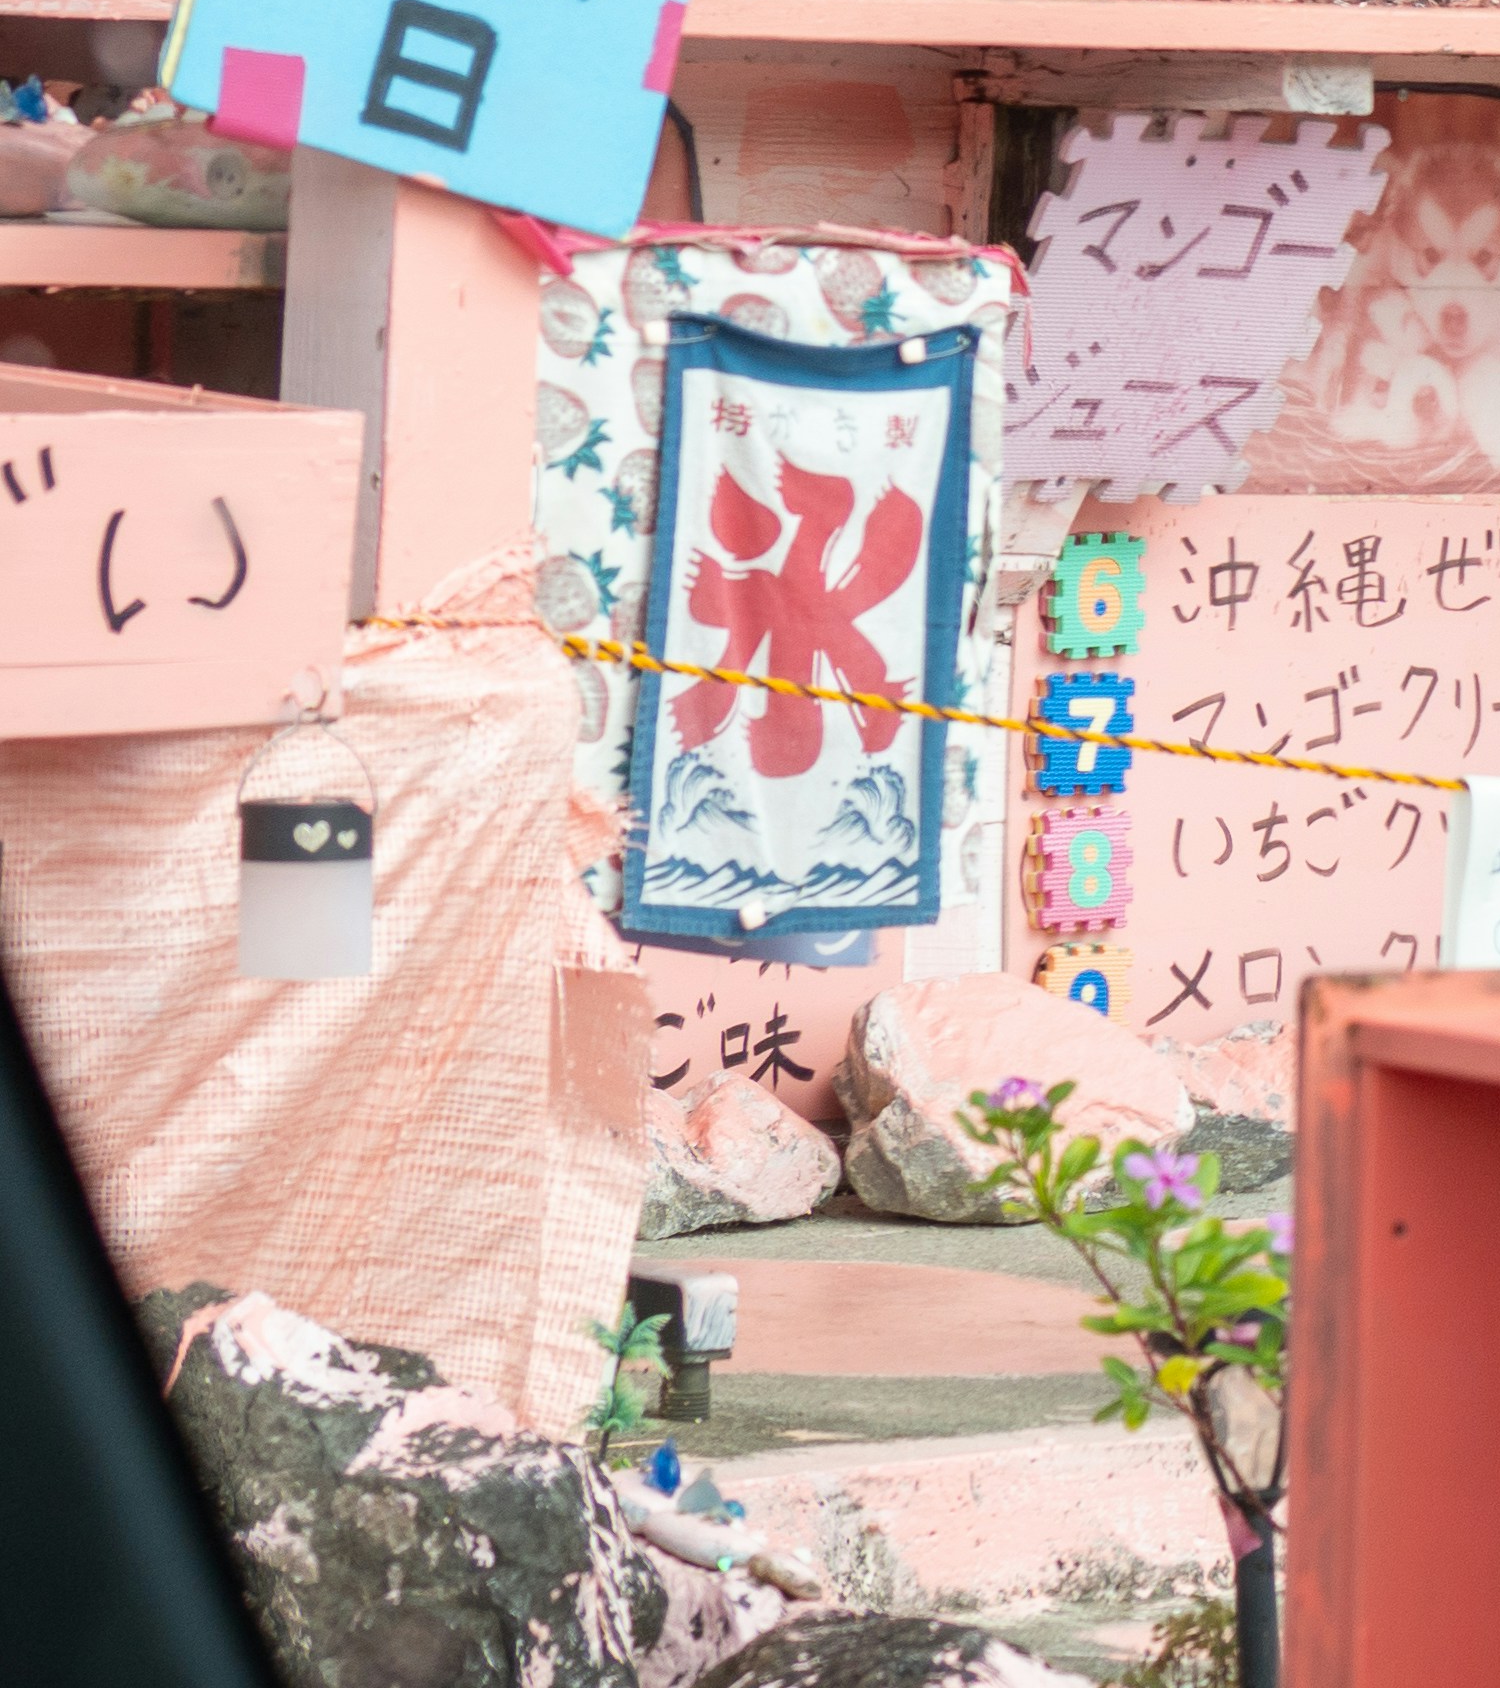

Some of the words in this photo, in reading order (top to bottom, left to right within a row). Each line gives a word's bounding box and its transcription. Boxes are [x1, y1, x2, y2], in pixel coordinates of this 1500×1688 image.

[1076, 169, 1338, 283] マンゴー
[666, 448, 924, 779] 氷
[1078, 557, 1123, 634] 6
[1068, 697, 1116, 773] 7
[1068, 830, 1114, 909] 8
